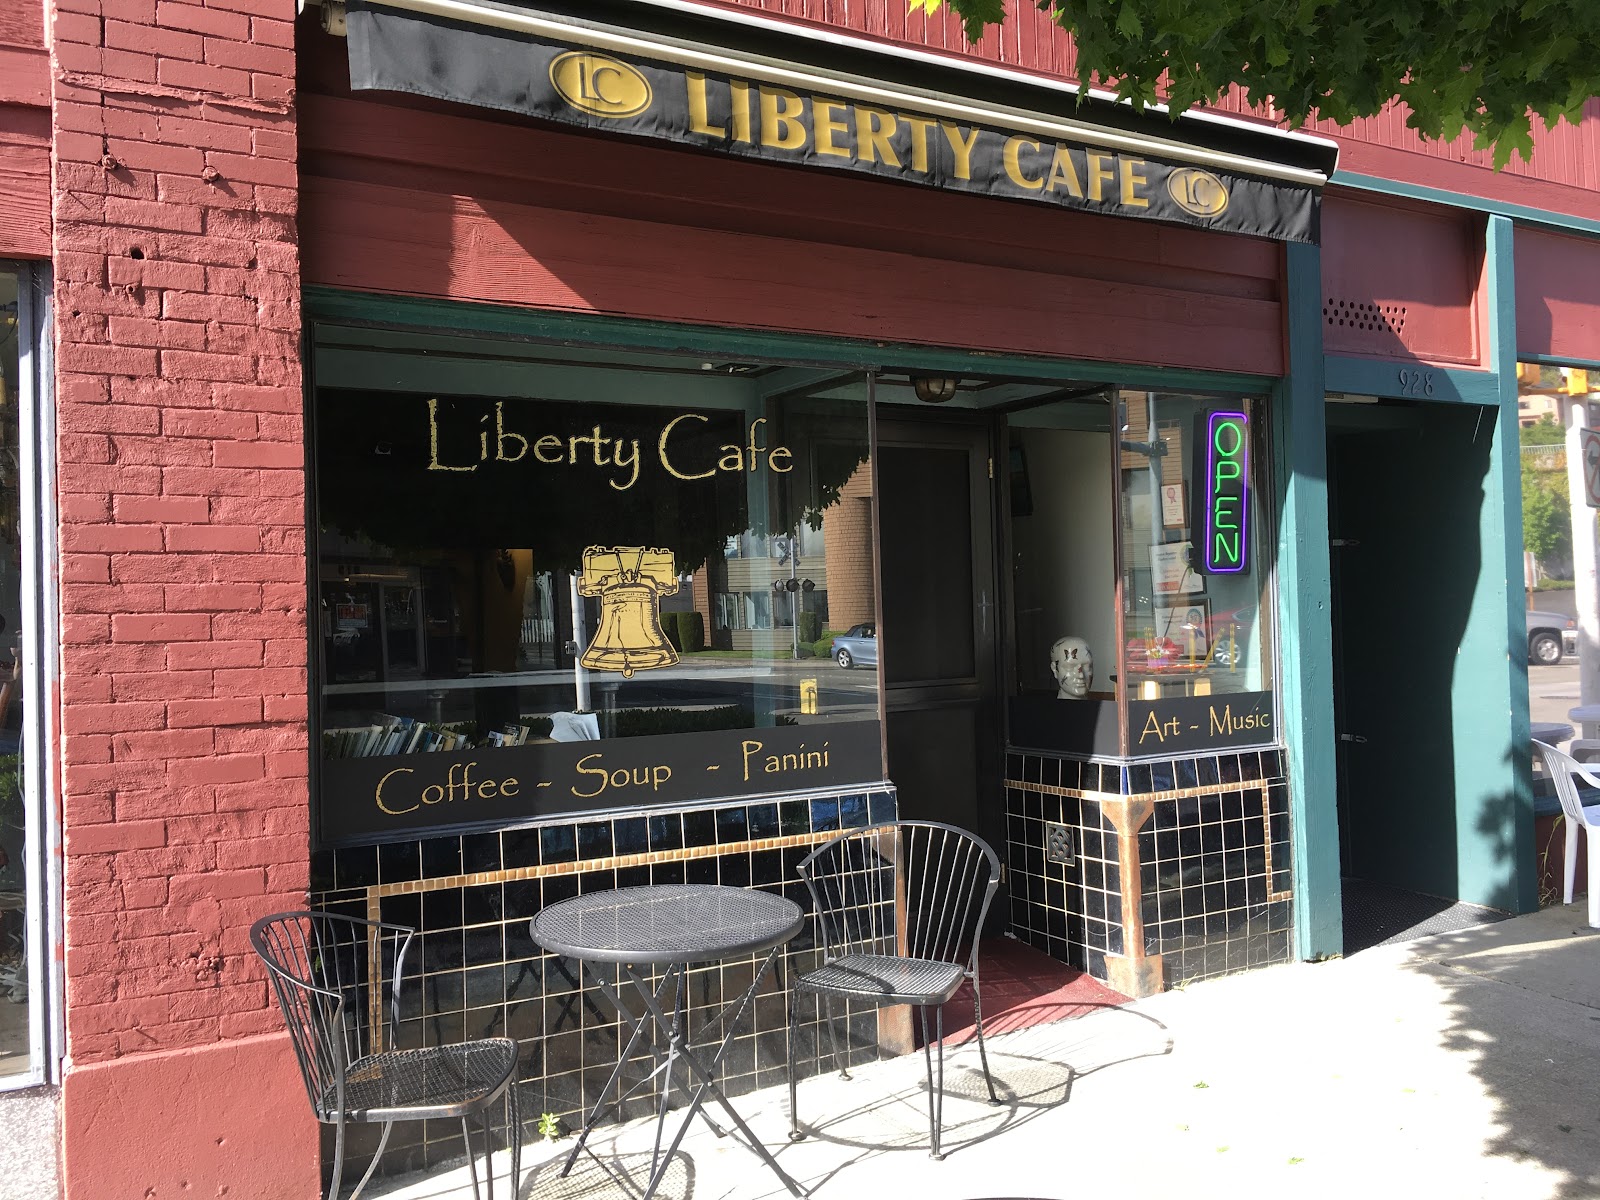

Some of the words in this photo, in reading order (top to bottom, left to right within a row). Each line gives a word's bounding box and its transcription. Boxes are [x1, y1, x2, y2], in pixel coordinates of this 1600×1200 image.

[578, 62, 623, 105] LC
[685, 70, 980, 180] LIBERTY
[1003, 134, 1149, 207] CAFE
[1184, 175, 1210, 207] LC
[1398, 368, 1434, 397] 928
[427, 398, 640, 490] Liberty
[658, 413, 793, 480] Cafe
[1214, 421, 1242, 563] OPEN
[1139, 711, 1181, 744] Art
[1209, 704, 1271, 737] Music
[375, 762, 519, 815] Coffee
[571, 753, 673, 798] Soup
[741, 740, 829, 781] Panini
